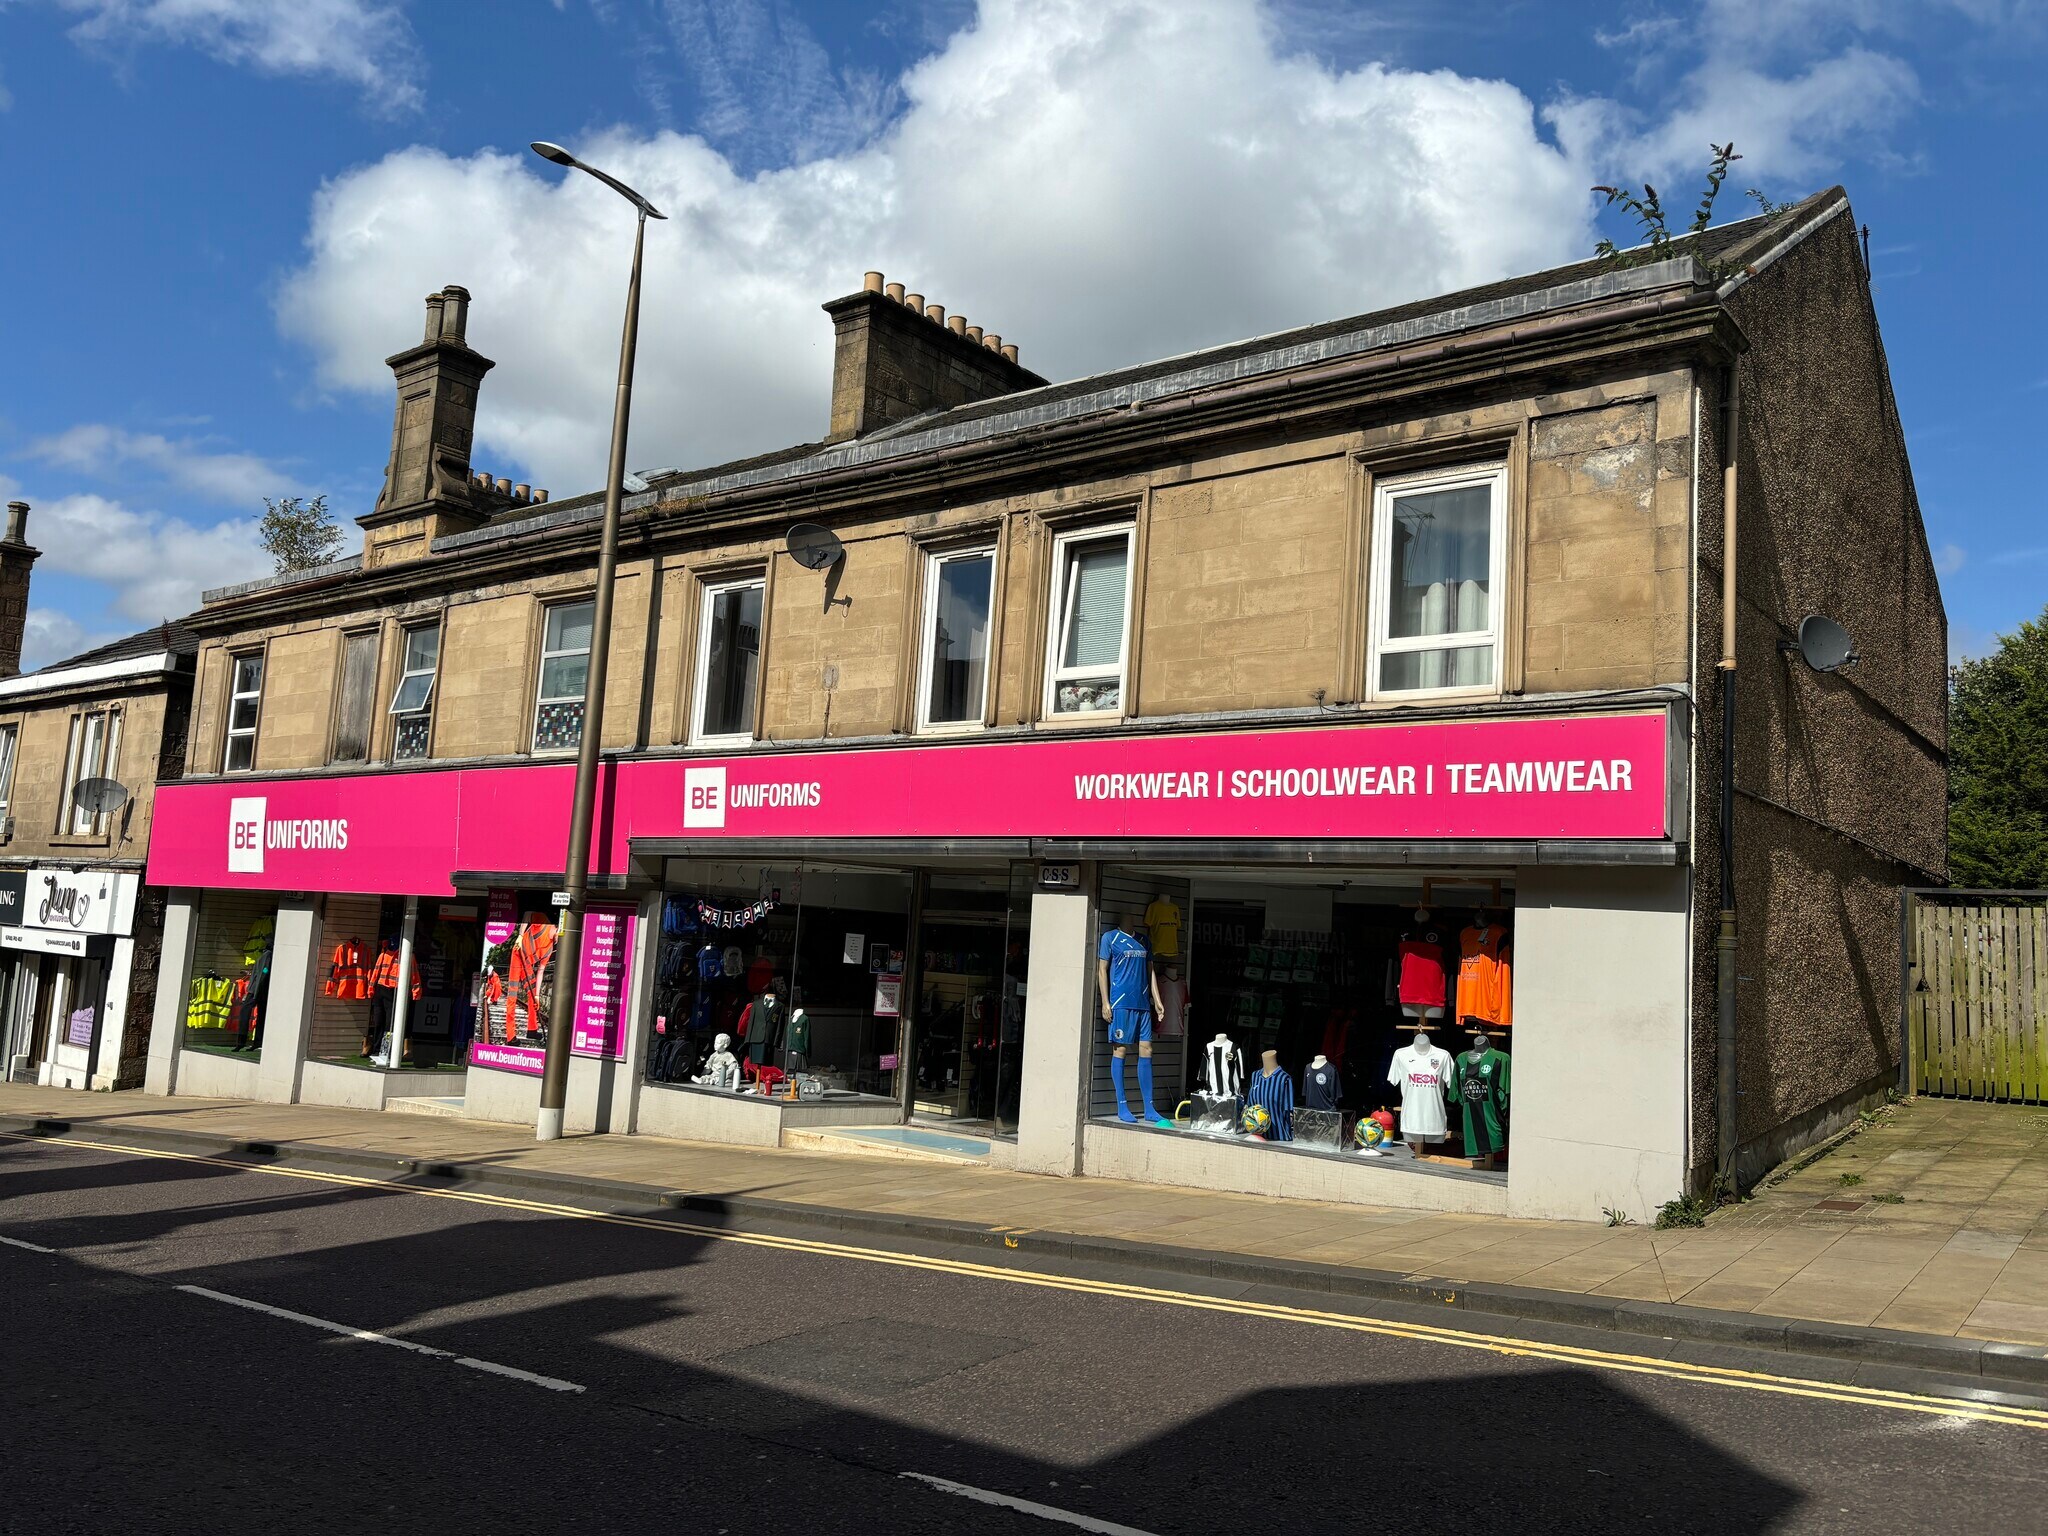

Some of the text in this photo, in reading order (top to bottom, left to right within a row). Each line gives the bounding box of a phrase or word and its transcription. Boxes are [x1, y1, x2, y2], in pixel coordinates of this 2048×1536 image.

[1074, 772, 1209, 800] WORKWEAR
[1231, 766, 1416, 798] SCHOOLWEAR
[1446, 759, 1633, 793] TEAMWEAR
[692, 782, 821, 810] BE UNIFORMS
[234, 818, 348, 850] BE UNIFORMS
[704, 898, 770, 923] WELCOME
[1408, 1073, 1438, 1084] NEON
